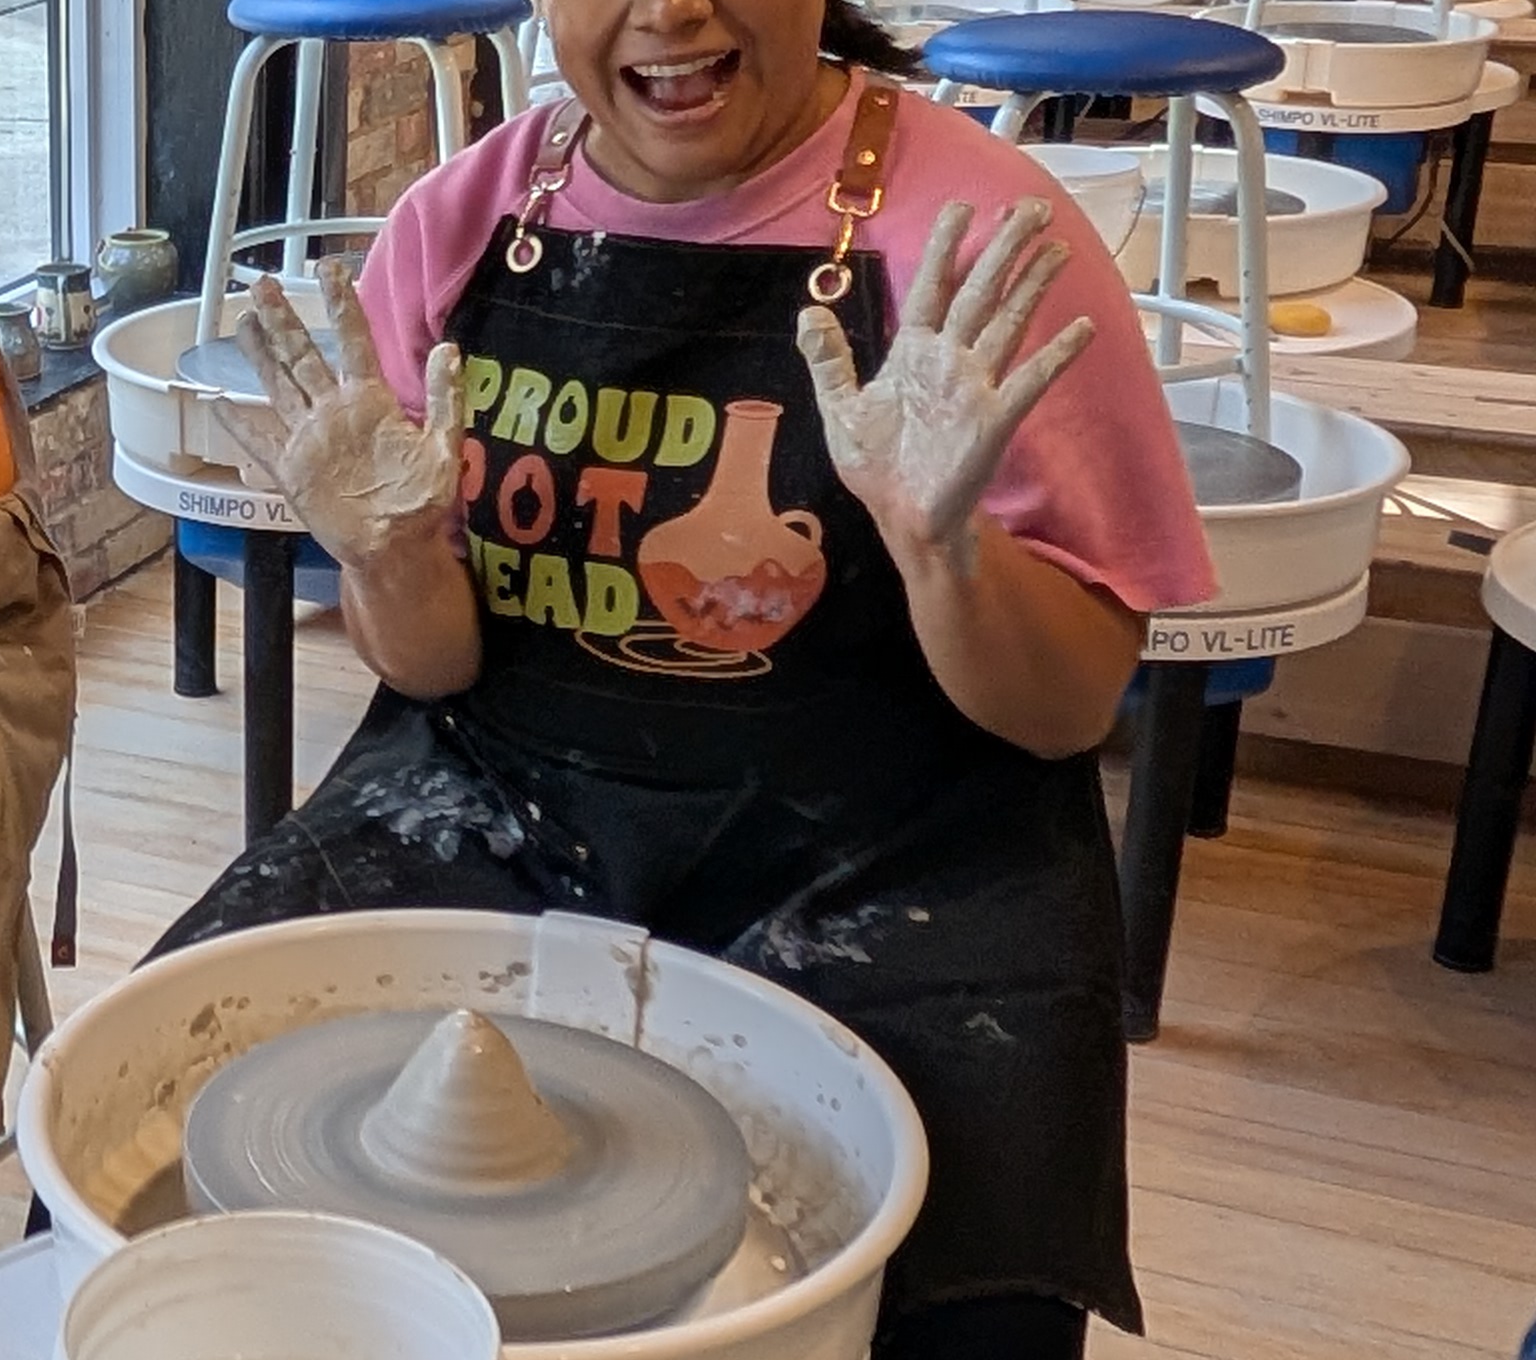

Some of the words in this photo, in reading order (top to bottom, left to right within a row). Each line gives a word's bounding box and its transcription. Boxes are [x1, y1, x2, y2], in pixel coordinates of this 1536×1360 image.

[1258, 108, 1315, 127] SHIMPO
[1320, 114, 1381, 128] VL-LITE
[464, 354, 717, 468] PROUD
[179, 491, 256, 521] SHIMPO
[467, 530, 640, 637] EAD
[1201, 624, 1296, 653] VL-LITE
